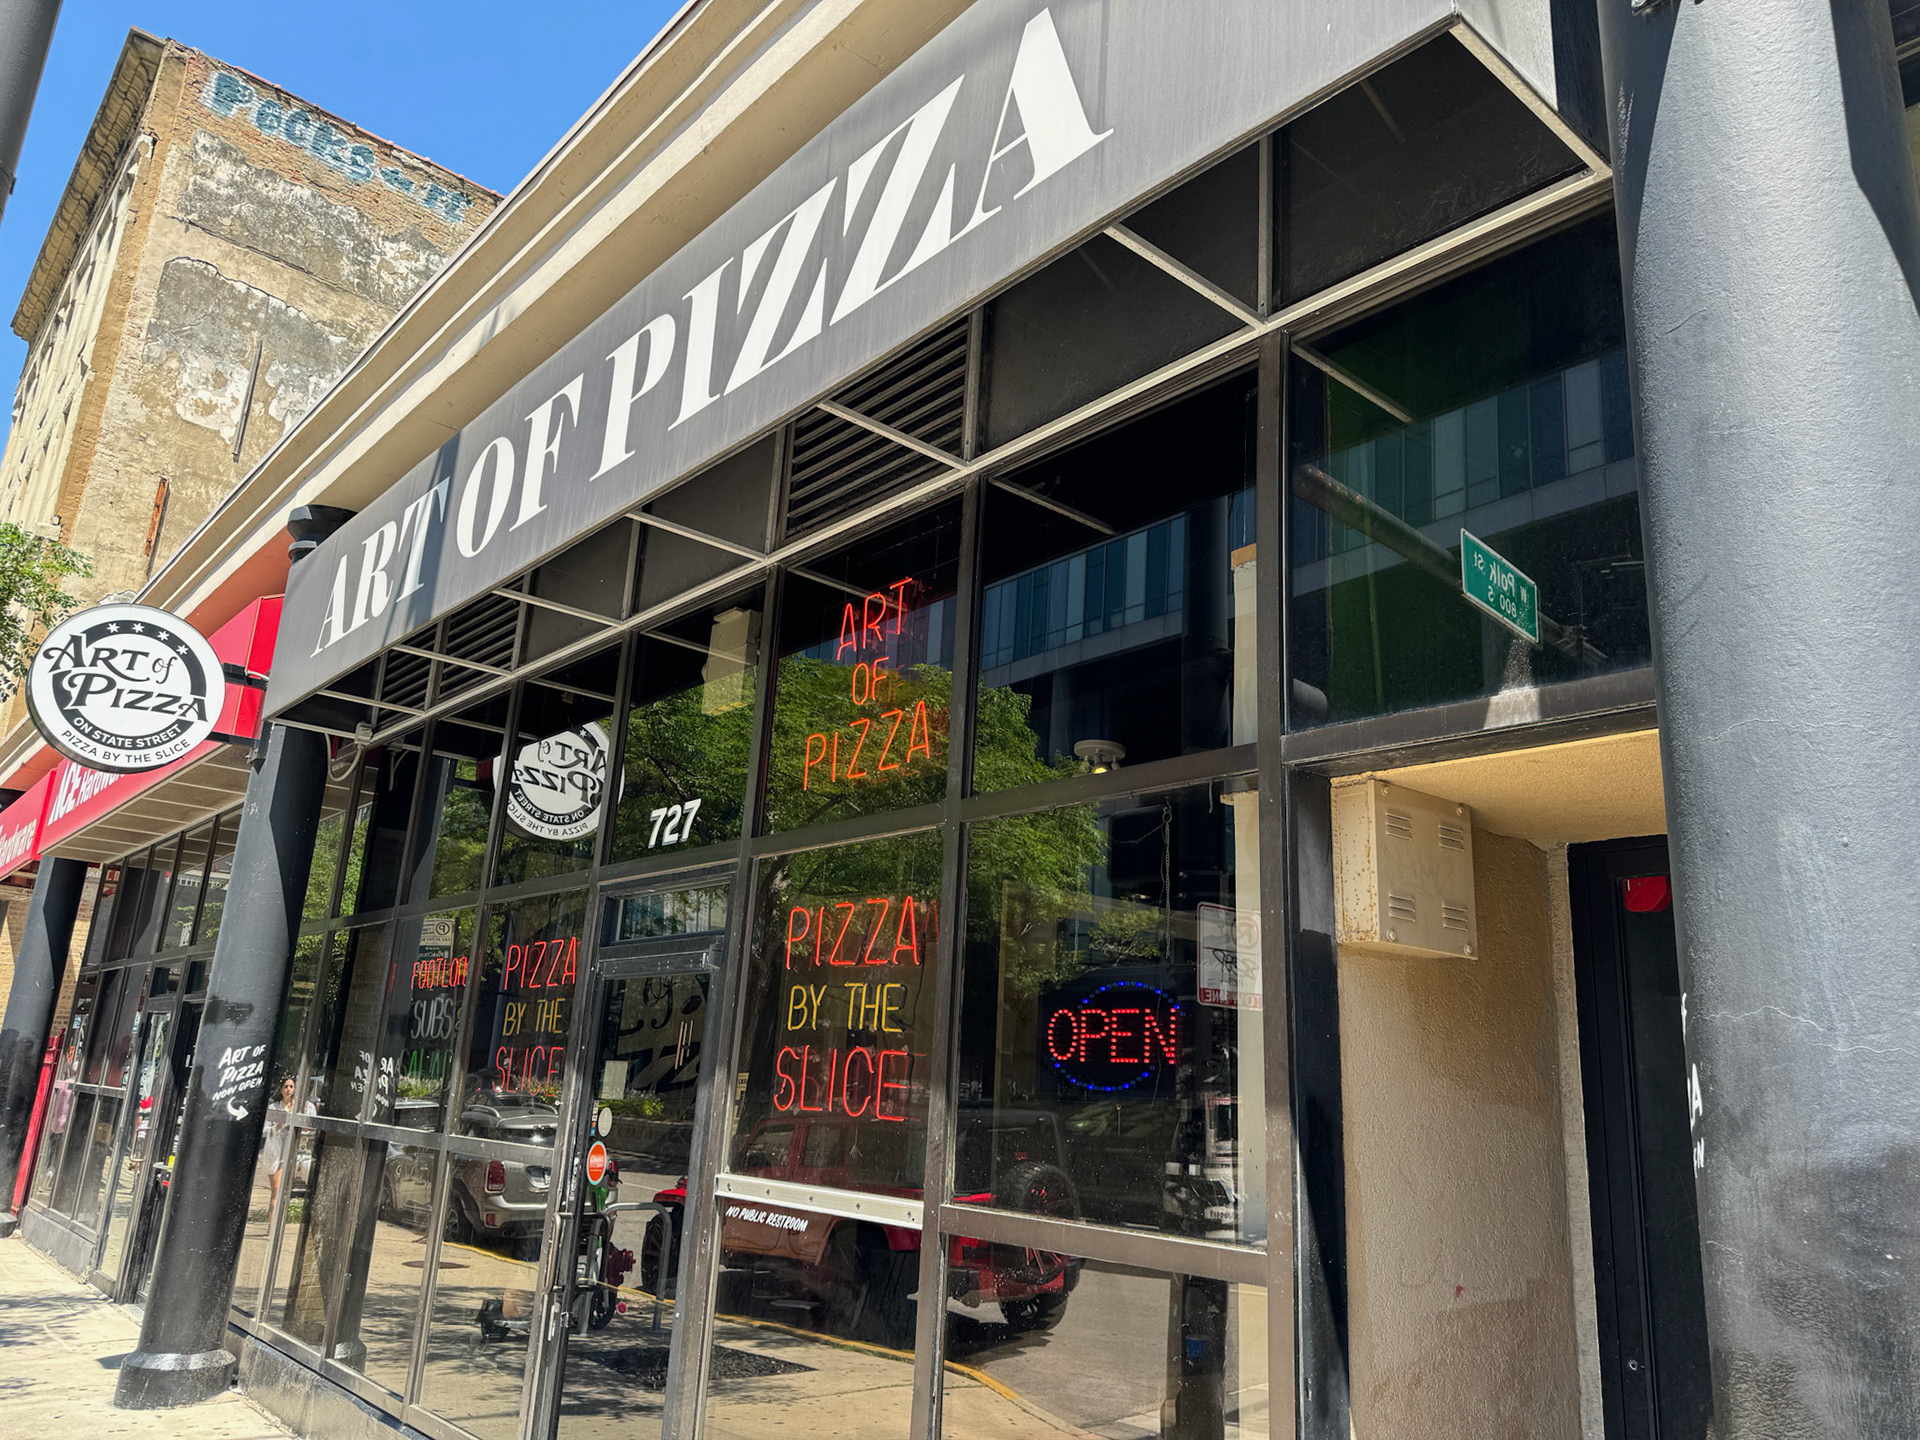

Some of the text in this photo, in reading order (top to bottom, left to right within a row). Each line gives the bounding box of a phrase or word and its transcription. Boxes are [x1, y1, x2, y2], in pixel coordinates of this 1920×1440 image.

[311, 8, 1115, 659] ART OF PIZZA
[836, 576, 912, 661] ART
[42, 634, 178, 685] ART of
[851, 656, 889, 705] OF
[64, 672, 209, 722] PIZZA
[61, 730, 190, 763] PIZZA BY THE SLICE
[73, 717, 182, 748] ON STATE STREET
[803, 700, 930, 791] PIZZA
[648, 798, 701, 849] 727
[786, 895, 921, 970] PIZZA
[503, 936, 577, 991] PIZZA
[410, 996, 454, 1040] SUBS
[503, 1001, 527, 1037] BY
[535, 998, 565, 1034] THE
[787, 982, 904, 1032] BY THE
[218, 1044, 266, 1069] ART OF
[1047, 1007, 1177, 1065] OPEN
[212, 1077, 263, 1101] NOW OPEN
[219, 1060, 264, 1087] PIZZA
[492, 1045, 564, 1097] SLICE
[773, 1045, 909, 1122] SLICE
[725, 1206, 809, 1232] NO PUBLIC RESTROOM
